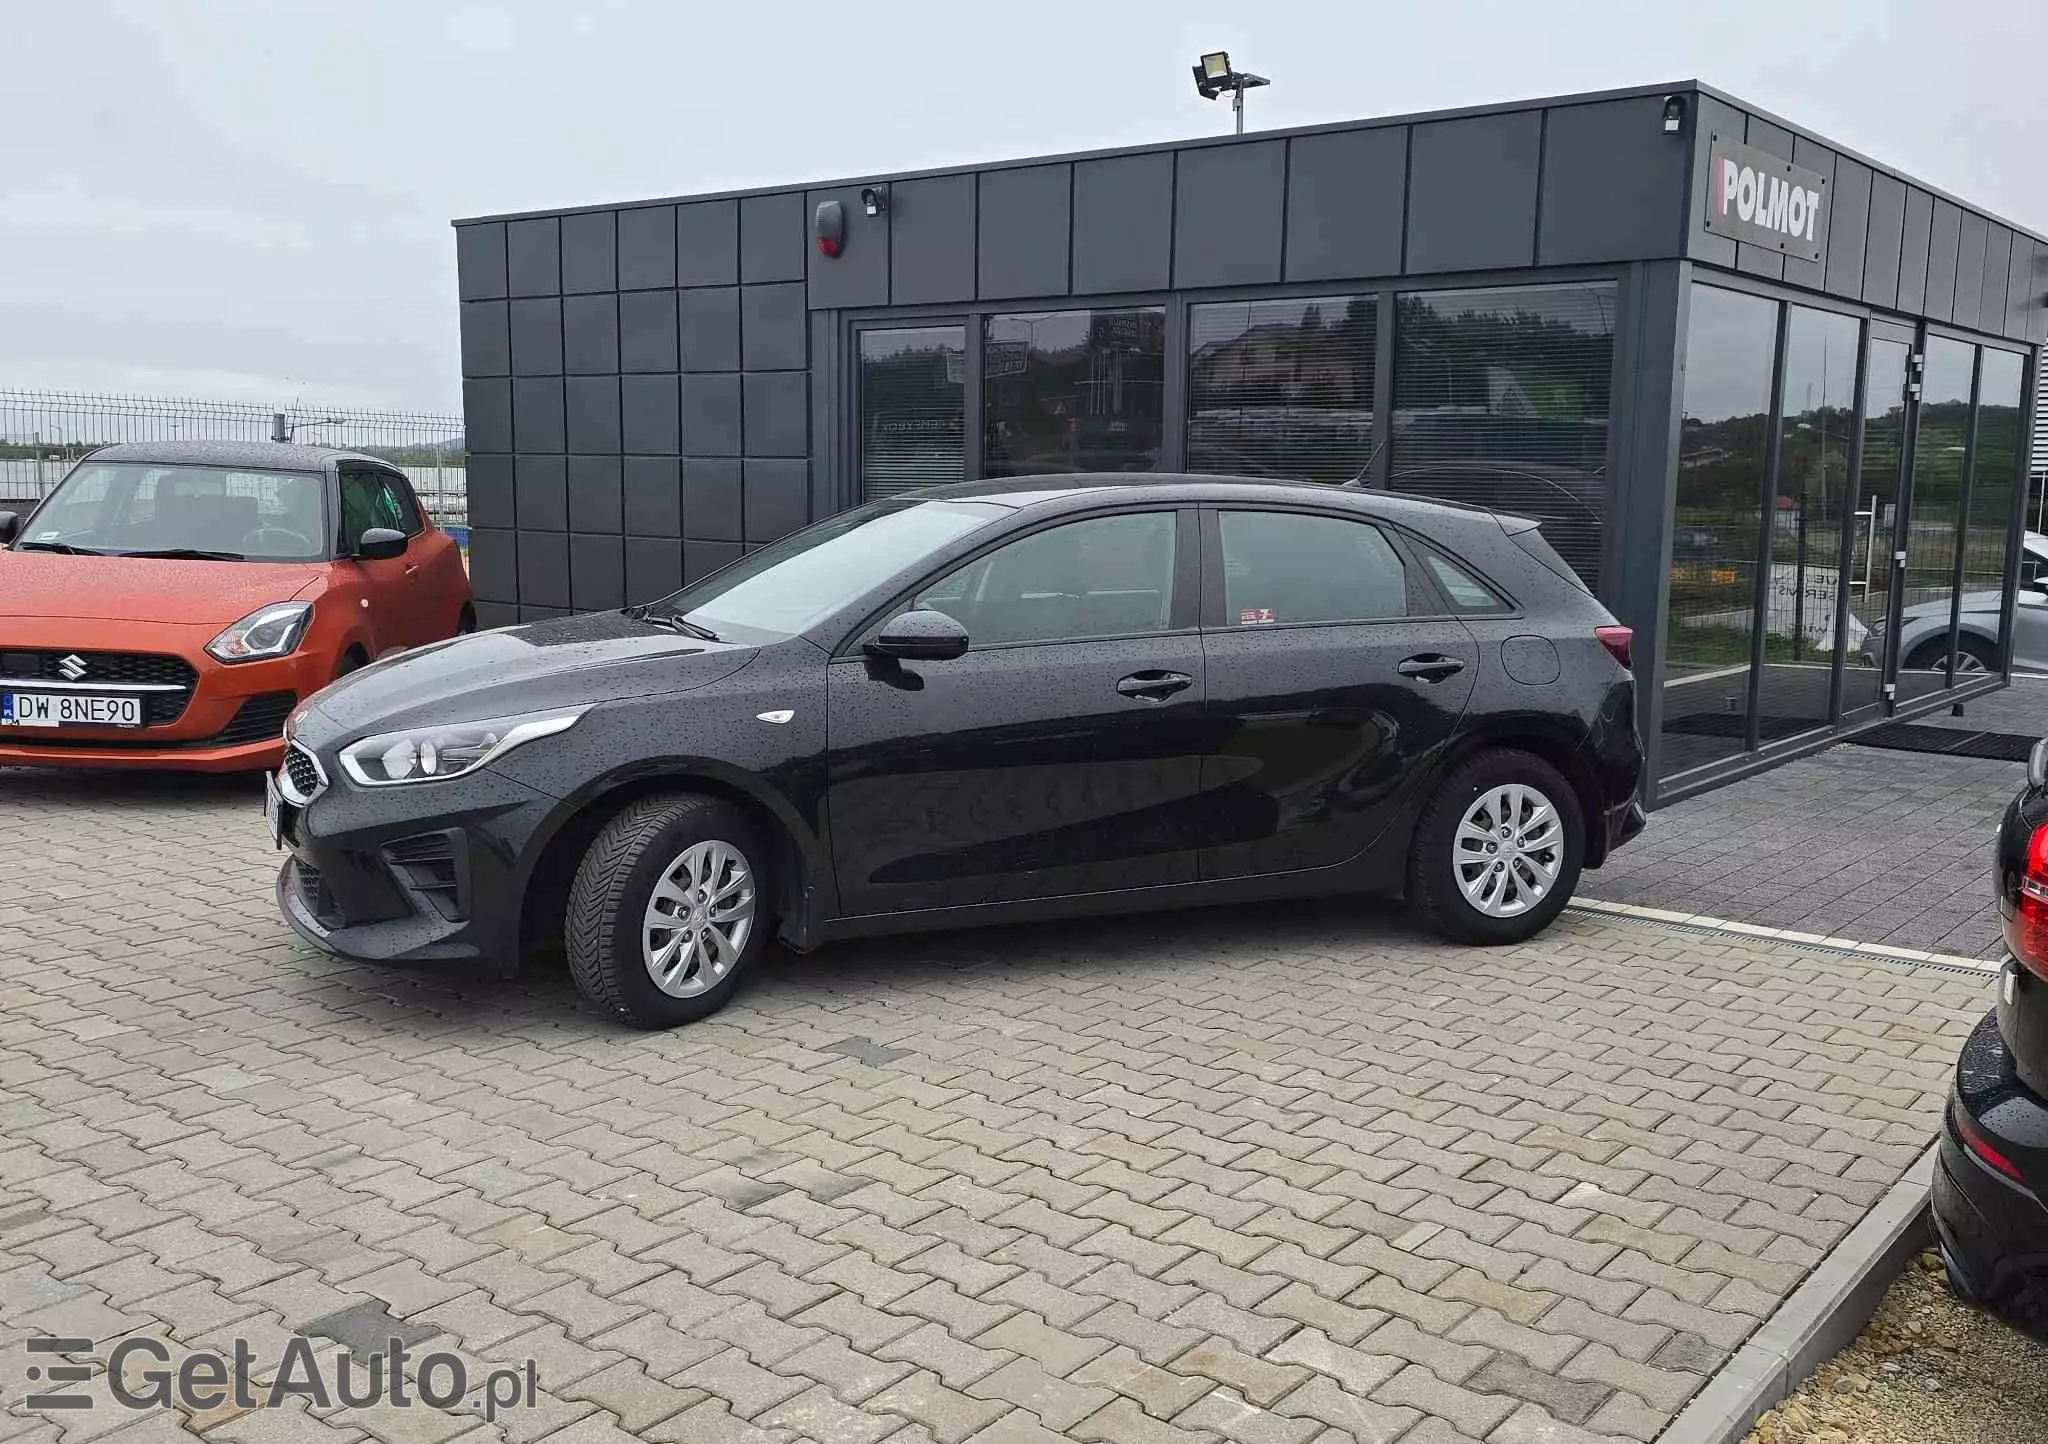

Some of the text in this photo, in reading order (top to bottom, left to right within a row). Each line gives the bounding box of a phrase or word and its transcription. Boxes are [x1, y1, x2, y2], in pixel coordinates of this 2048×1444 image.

[1722, 158, 1820, 241] POLMOT
[19, 696, 135, 721] DW 8NE90
